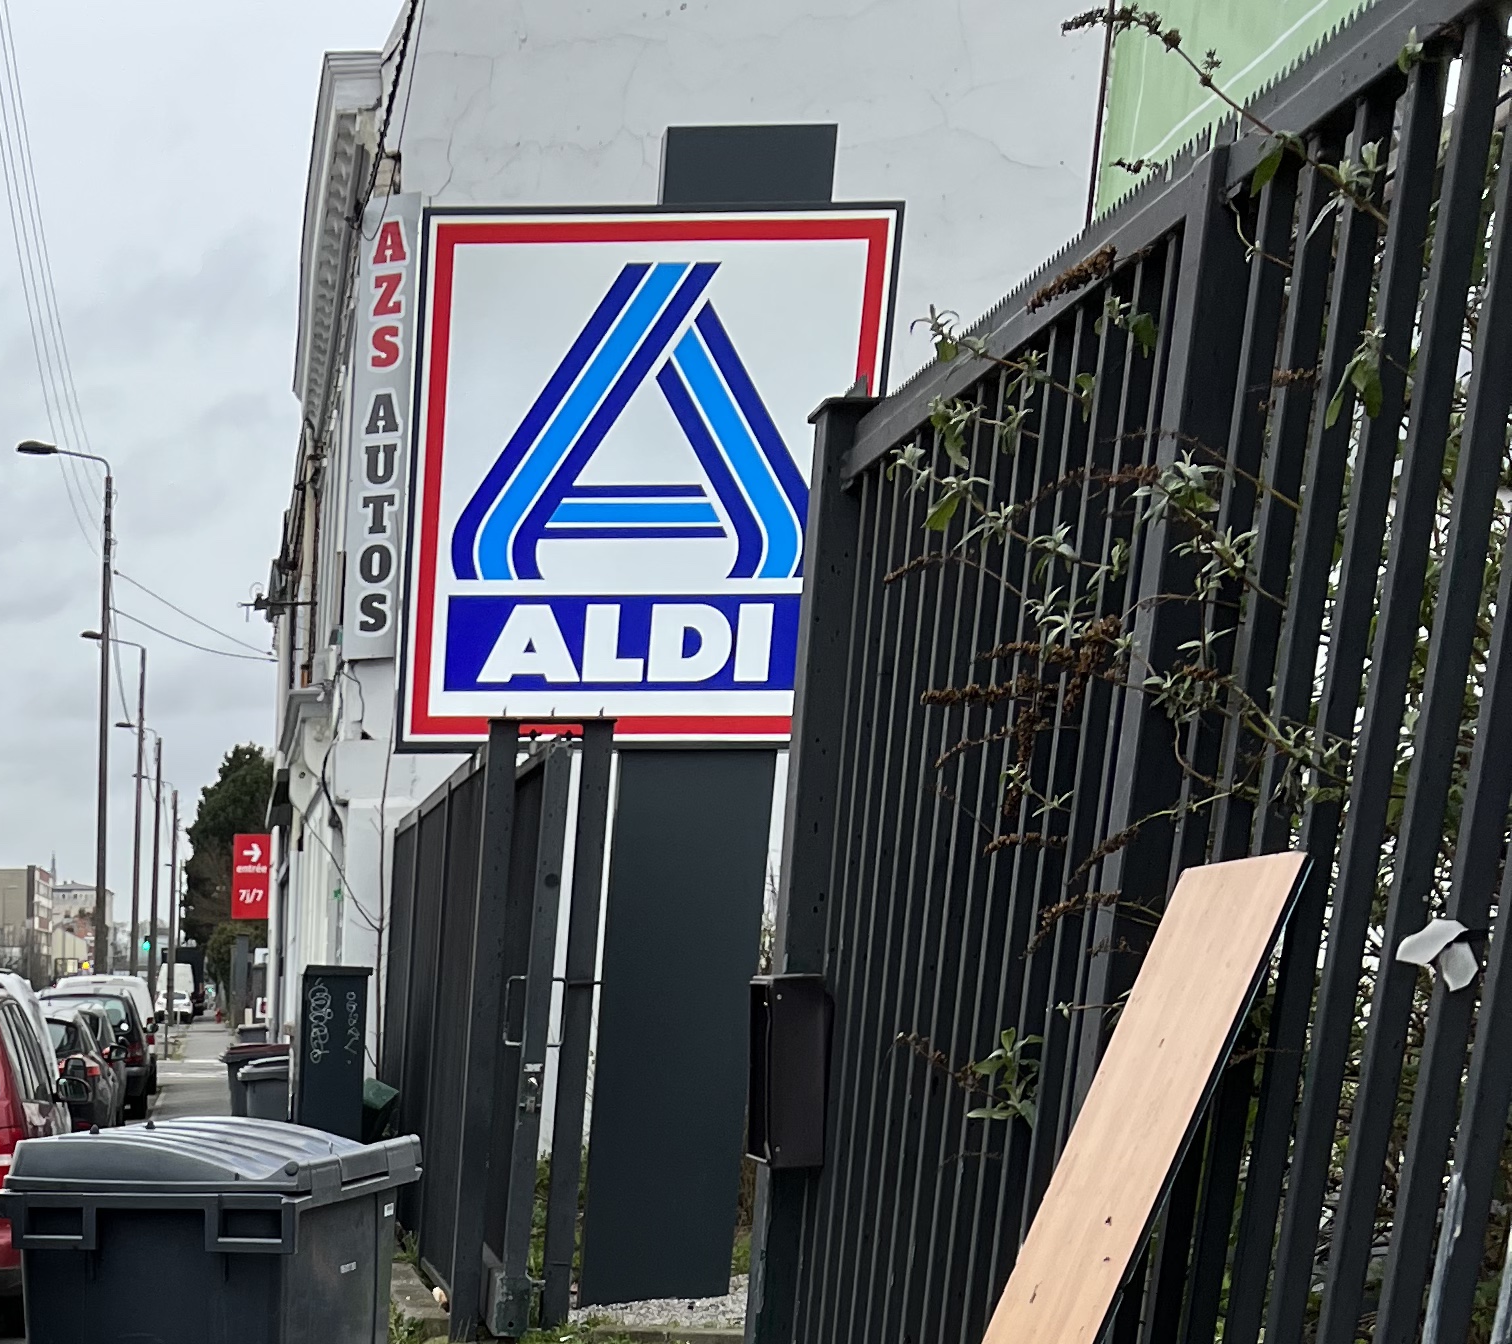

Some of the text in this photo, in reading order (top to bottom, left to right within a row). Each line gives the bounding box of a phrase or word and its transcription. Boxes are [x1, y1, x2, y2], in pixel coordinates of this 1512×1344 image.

[358, 219, 408, 633] AZS AUTOS
[476, 602, 776, 684] ALDI
